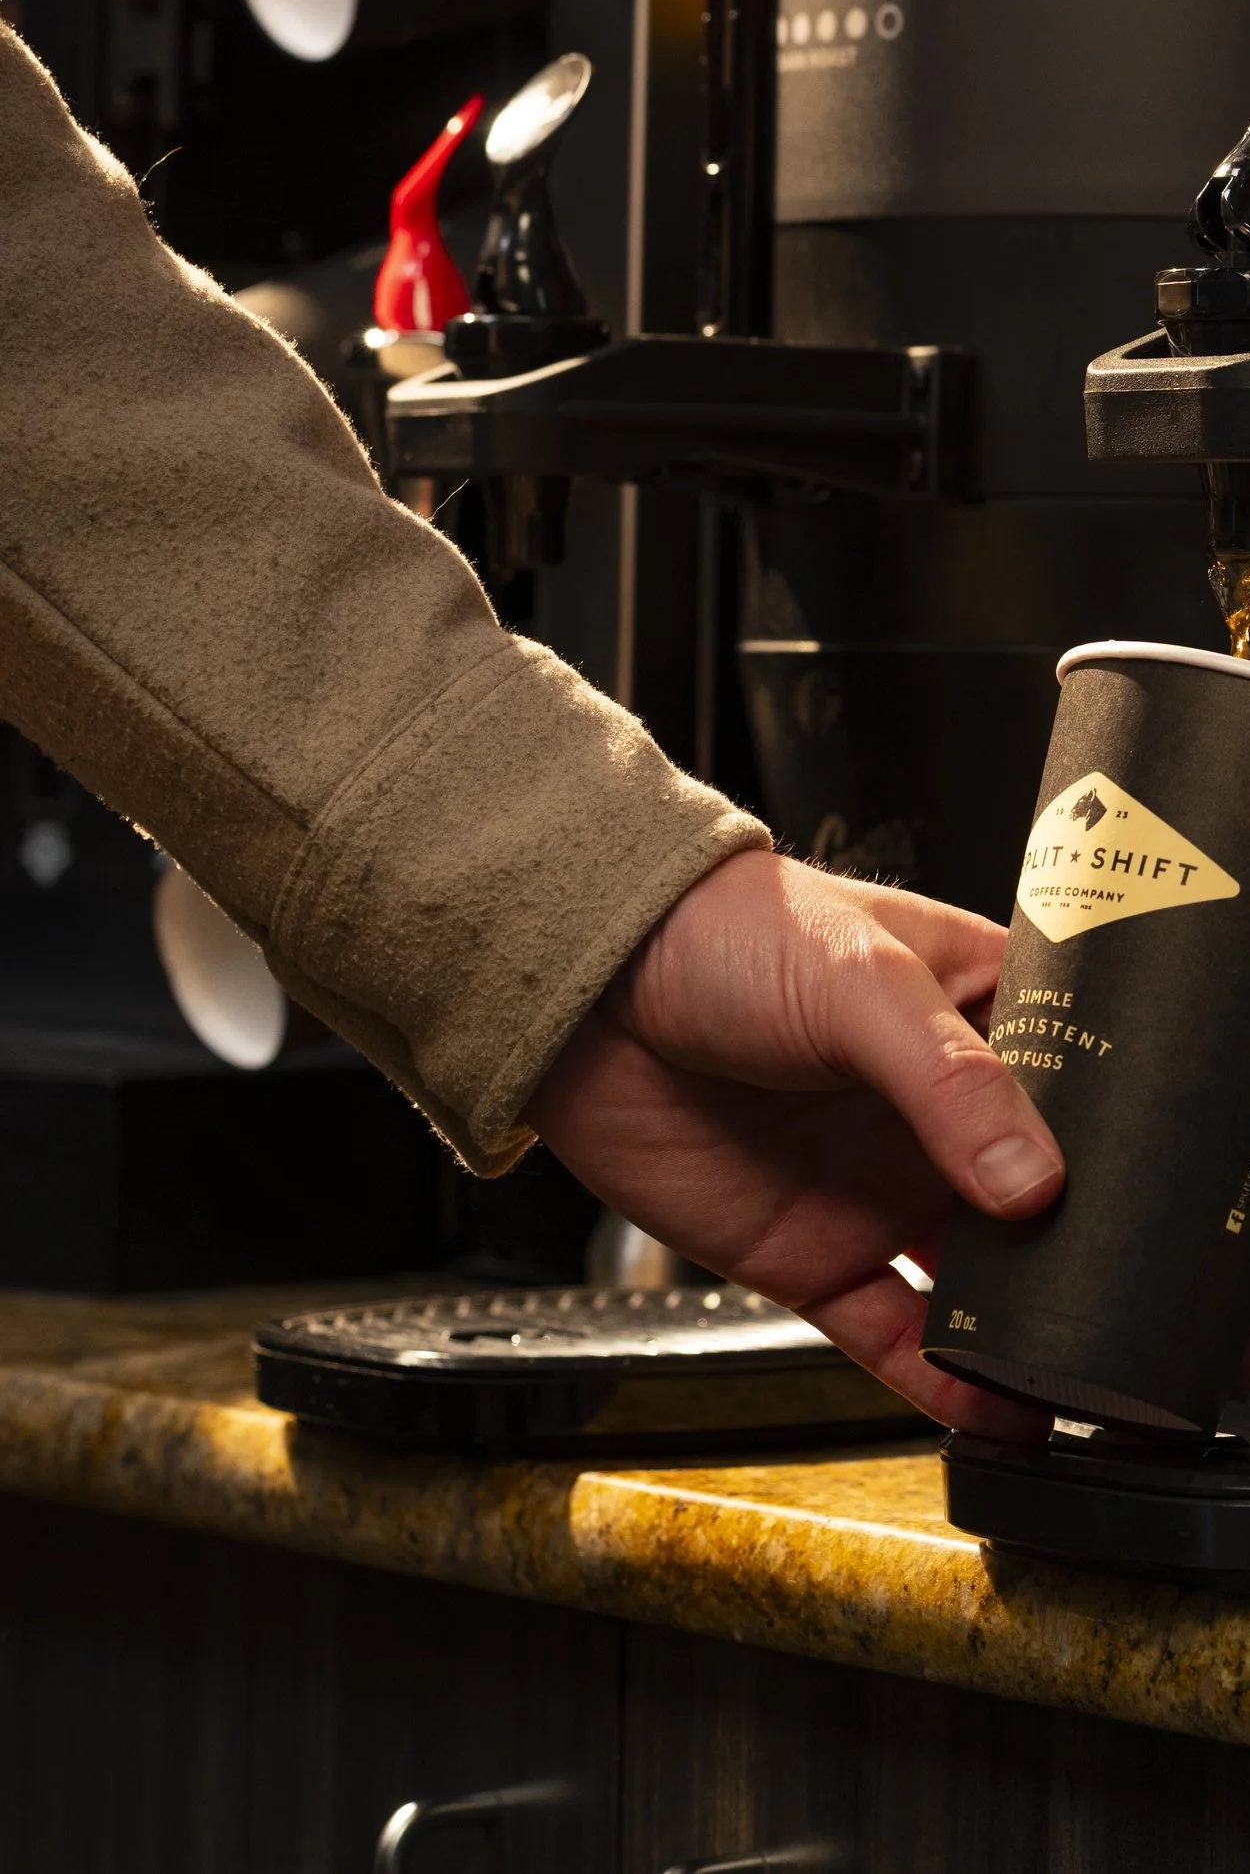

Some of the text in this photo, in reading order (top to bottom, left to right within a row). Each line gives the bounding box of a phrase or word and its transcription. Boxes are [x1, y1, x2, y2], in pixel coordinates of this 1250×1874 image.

[1115, 810, 1129, 820] 23
[1090, 846, 1200, 887] SHIFT
[1029, 886, 1126, 904] COFFEE COMPANY
[1017, 988, 1074, 1008] SIMPLE
[988, 1017, 1113, 1057] CONSISTENT
[1000, 1050, 1064, 1071] NO FUSS
[948, 1309, 977, 1332] 20 oz.
